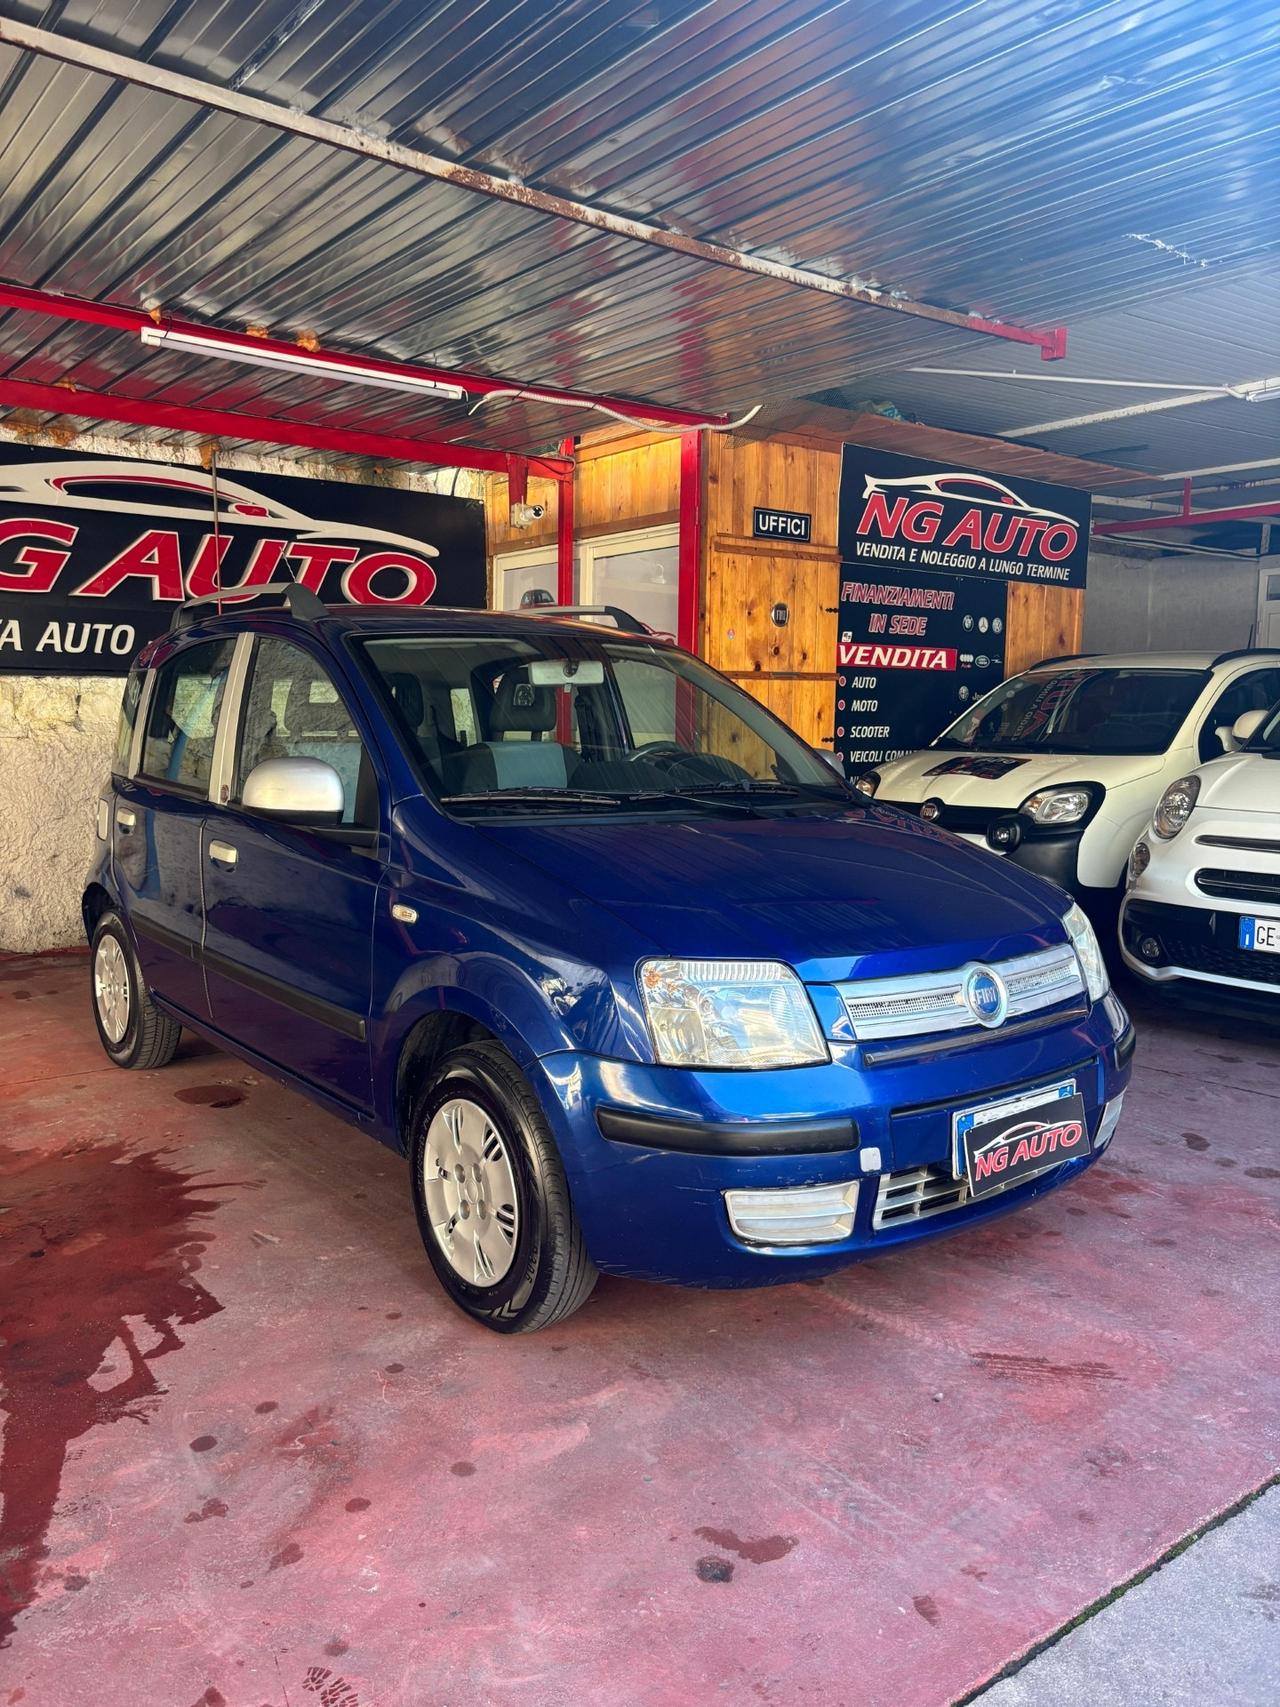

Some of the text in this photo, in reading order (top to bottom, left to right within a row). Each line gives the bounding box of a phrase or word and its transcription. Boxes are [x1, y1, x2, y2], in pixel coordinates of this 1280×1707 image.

[759, 514, 805, 536] UFFICI
[856, 492, 1078, 561] NG AUTO
[70, 530, 437, 606] AUTO
[856, 541, 1071, 581] VENDITA E NOLEGGIO A LUNGO TERMINE
[841, 581, 955, 611] FINANZIAMENTI
[868, 613, 928, 636] IN SEDE
[0, 618, 135, 655] A AUTO
[839, 644, 947, 669] VENDITA
[851, 676, 877, 689] AUTO
[851, 700, 878, 712] MOTO
[850, 726, 890, 738] SCOOTER
[850, 750, 882, 763] VEICOLI
[1256, 926, 1276, 946] GE
[975, 986, 998, 1005] FIAT
[975, 1123, 1082, 1181] NG AUTO
